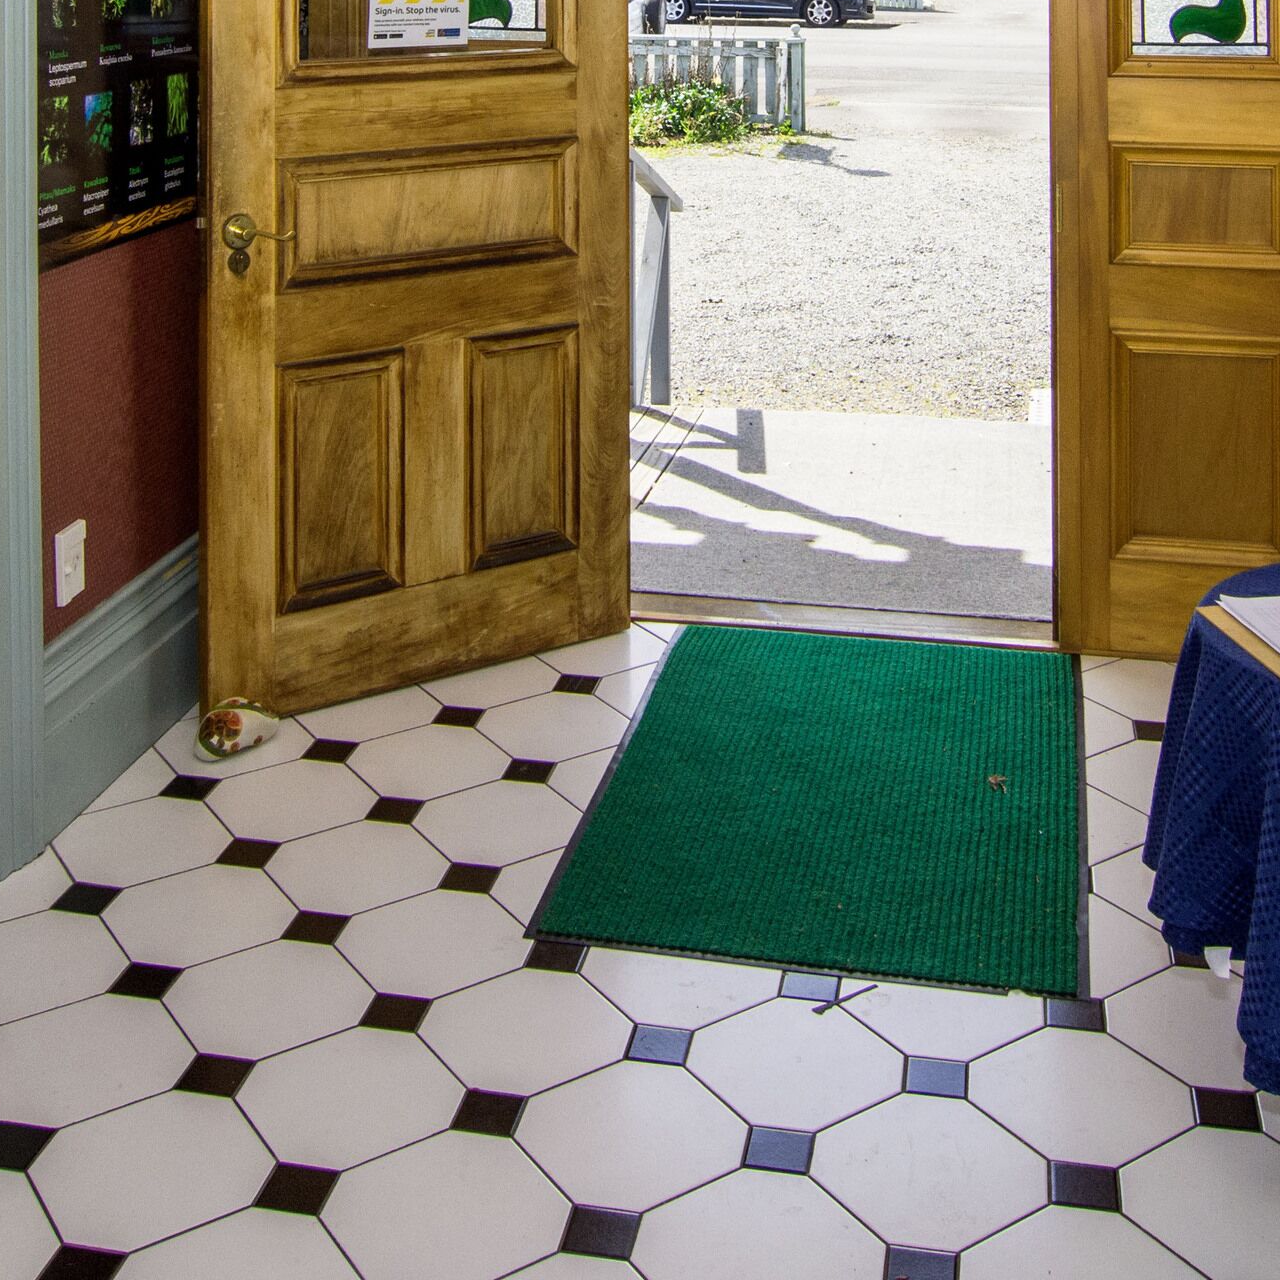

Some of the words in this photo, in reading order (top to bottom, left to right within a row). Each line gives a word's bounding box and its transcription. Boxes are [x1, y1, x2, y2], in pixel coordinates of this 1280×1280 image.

[375, 7, 404, 16] Sign-in.
[406, 7, 424, 15] Stop
[425, 6, 438, 14] the
